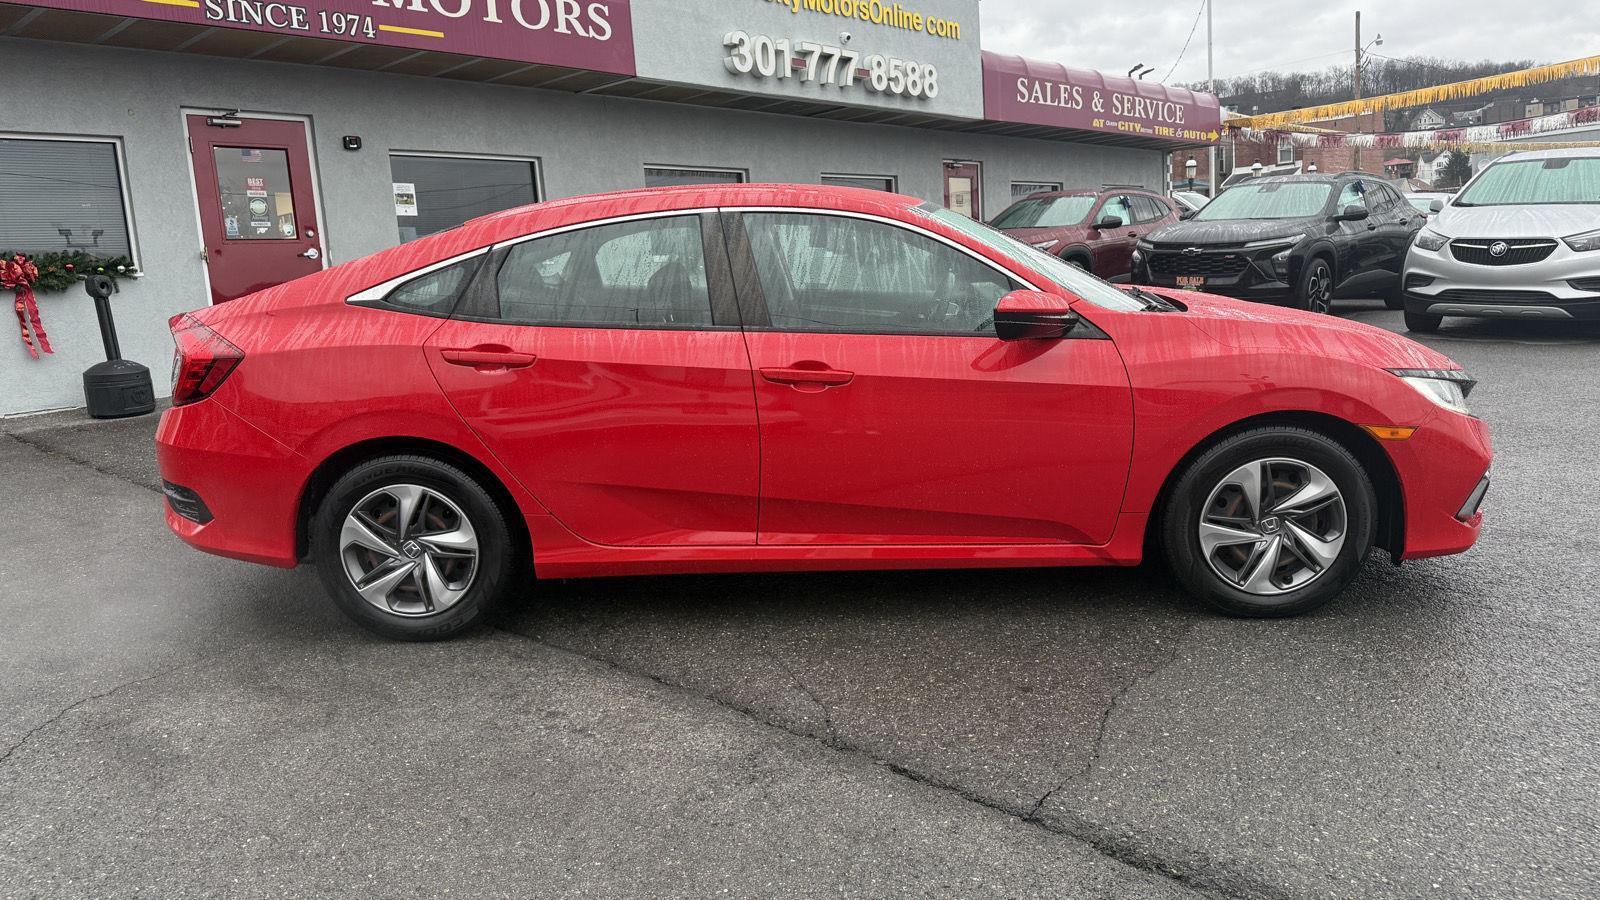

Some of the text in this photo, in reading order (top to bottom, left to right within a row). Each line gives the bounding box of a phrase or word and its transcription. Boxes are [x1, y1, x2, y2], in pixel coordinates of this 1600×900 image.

[205, 0, 377, 39] SINCE 1974
[1016, 77, 1185, 124] SALES & SERVICE
[1092, 118, 1105, 128] AT
[1117, 120, 1142, 133] CITY
[1154, 125, 1175, 136] TIRE
[1175, 127, 1183, 138] &
[1183, 129, 1207, 141] AUTO
